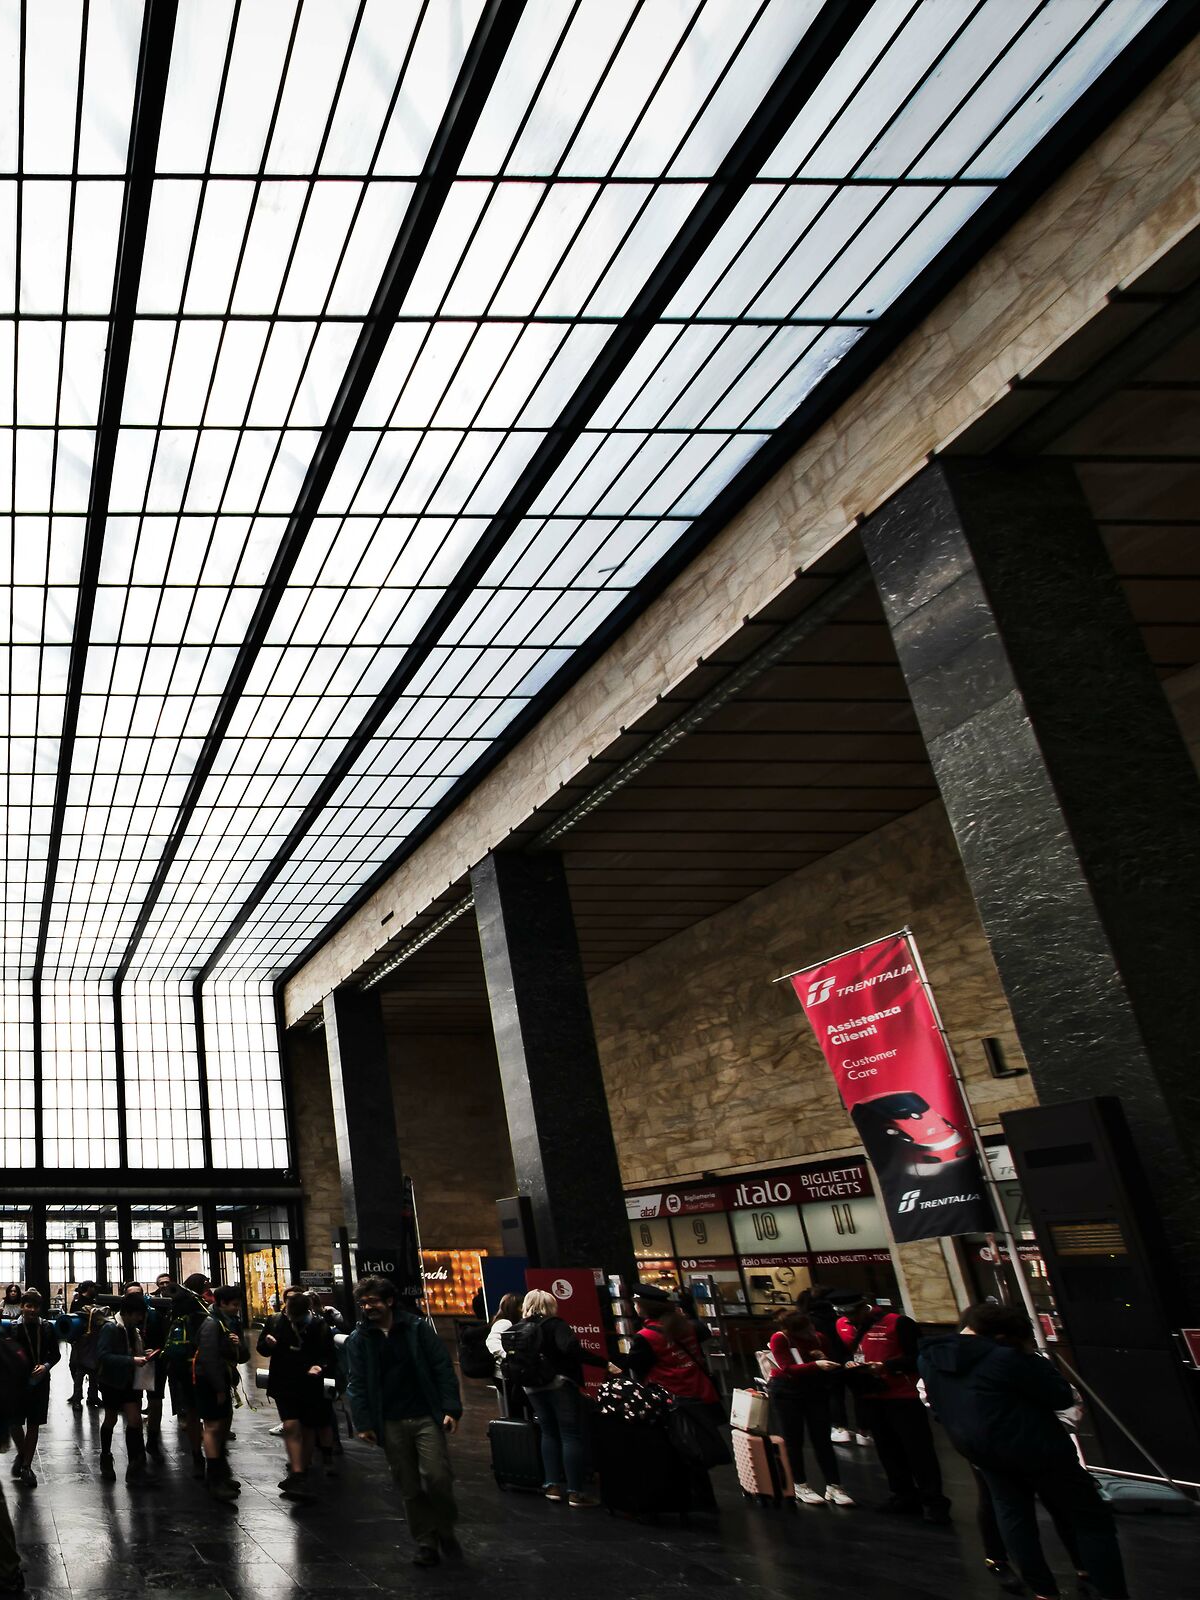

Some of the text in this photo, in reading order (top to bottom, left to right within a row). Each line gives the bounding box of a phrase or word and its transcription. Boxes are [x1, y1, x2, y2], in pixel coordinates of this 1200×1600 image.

[836, 964, 913, 997] TRENITALIA
[827, 1005, 902, 1035] Assistenza
[831, 1024, 878, 1046] Clienti
[842, 1048, 897, 1069] Customer
[847, 1067, 878, 1081] Care
[800, 1167, 863, 1186] BIGLIETTI
[807, 1181, 862, 1198] TICKETS
[640, 1205, 657, 1218] ataf
[919, 1193, 982, 1210] TRENITALIA
[752, 1211, 779, 1241] 10
[831, 1203, 856, 1235] 11
[692, 1219, 708, 1245] 9
[840, 1254, 867, 1262] BIGLIETTI
[872, 1253, 891, 1261] TICKE
